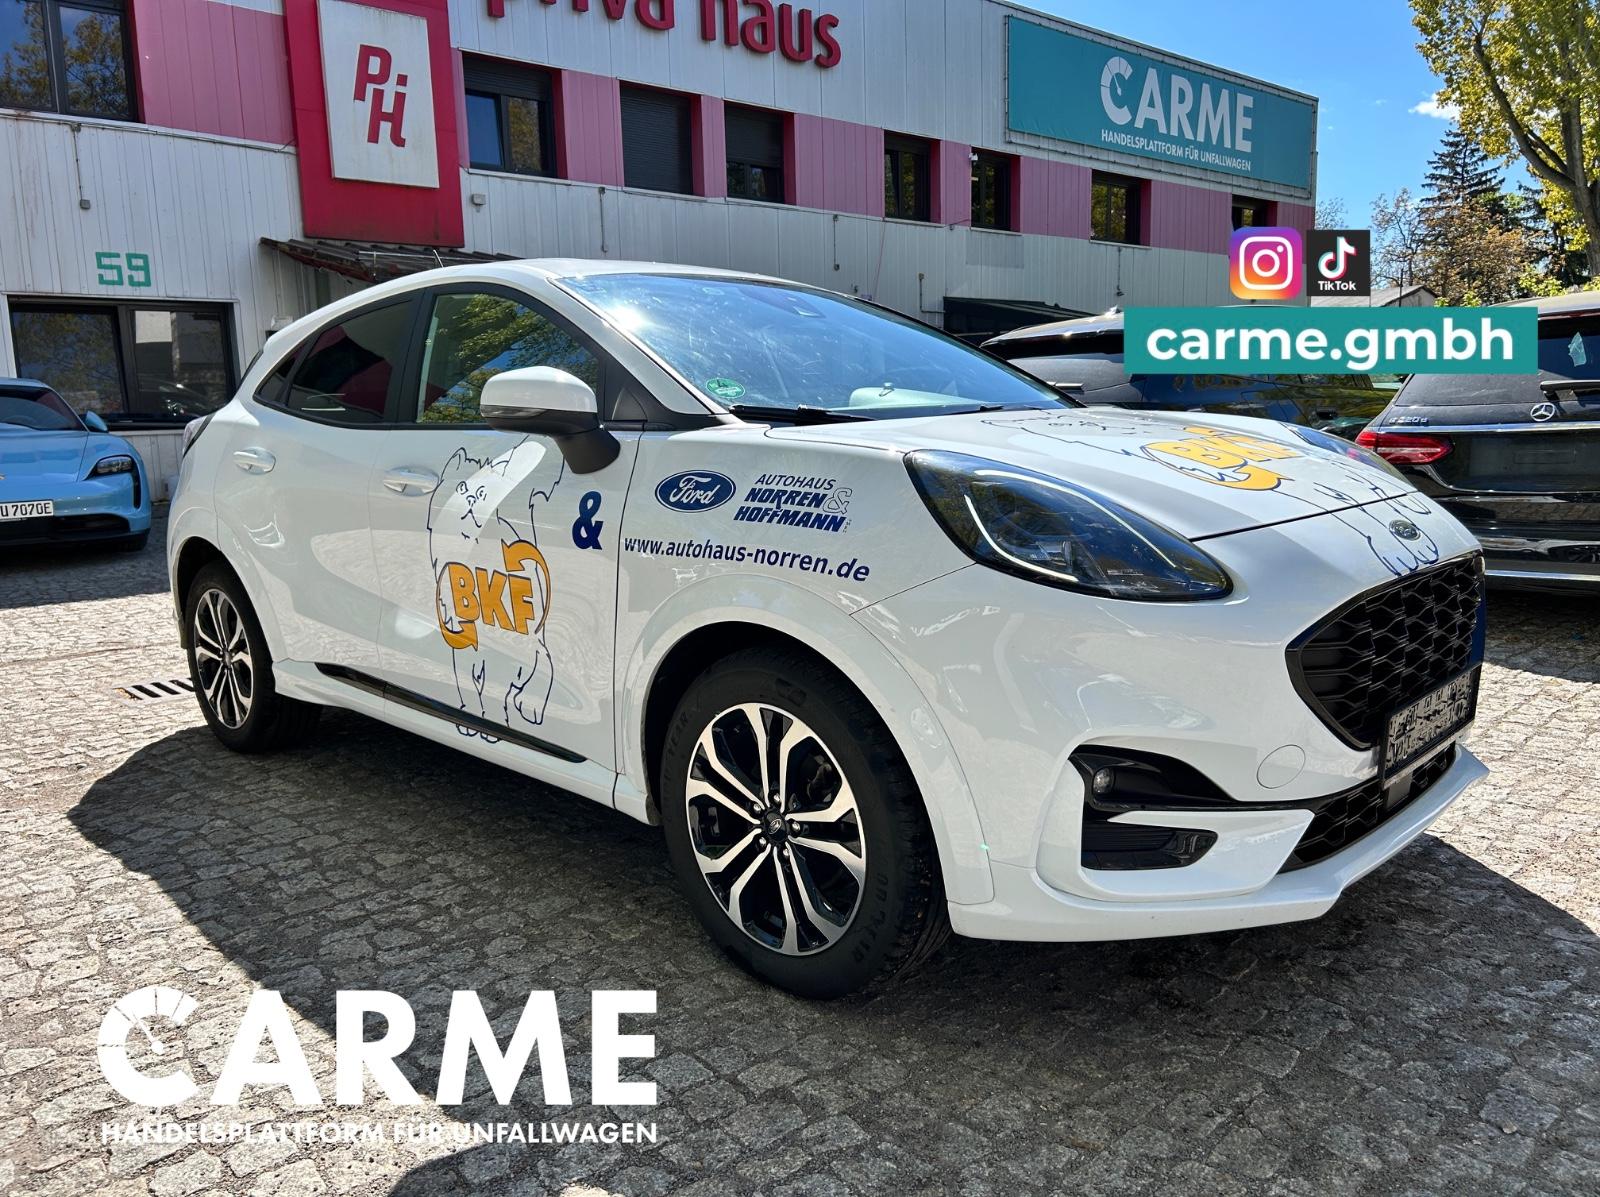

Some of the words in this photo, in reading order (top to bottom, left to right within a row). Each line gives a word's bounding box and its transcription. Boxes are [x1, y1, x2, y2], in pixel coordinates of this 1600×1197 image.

[1100, 56, 1254, 152] CARME
[1101, 129, 1184, 158] HANDELSPLATTFORM
[1184, 145, 1199, 161] FÜR
[1200, 152, 1251, 171] UNFALLWAGEN
[96, 252, 151, 288] 59
[669, 475, 721, 504] Ford
[755, 474, 836, 491] AUTOHAUS
[11, 503, 52, 517] 7070E
[733, 506, 847, 532] HOFFMANN
[744, 487, 828, 510] NORREN
[822, 487, 853, 515] &
[572, 491, 604, 550] &
[624, 537, 870, 582] www.autohaus-norren.de
[447, 562, 535, 635] BKF
